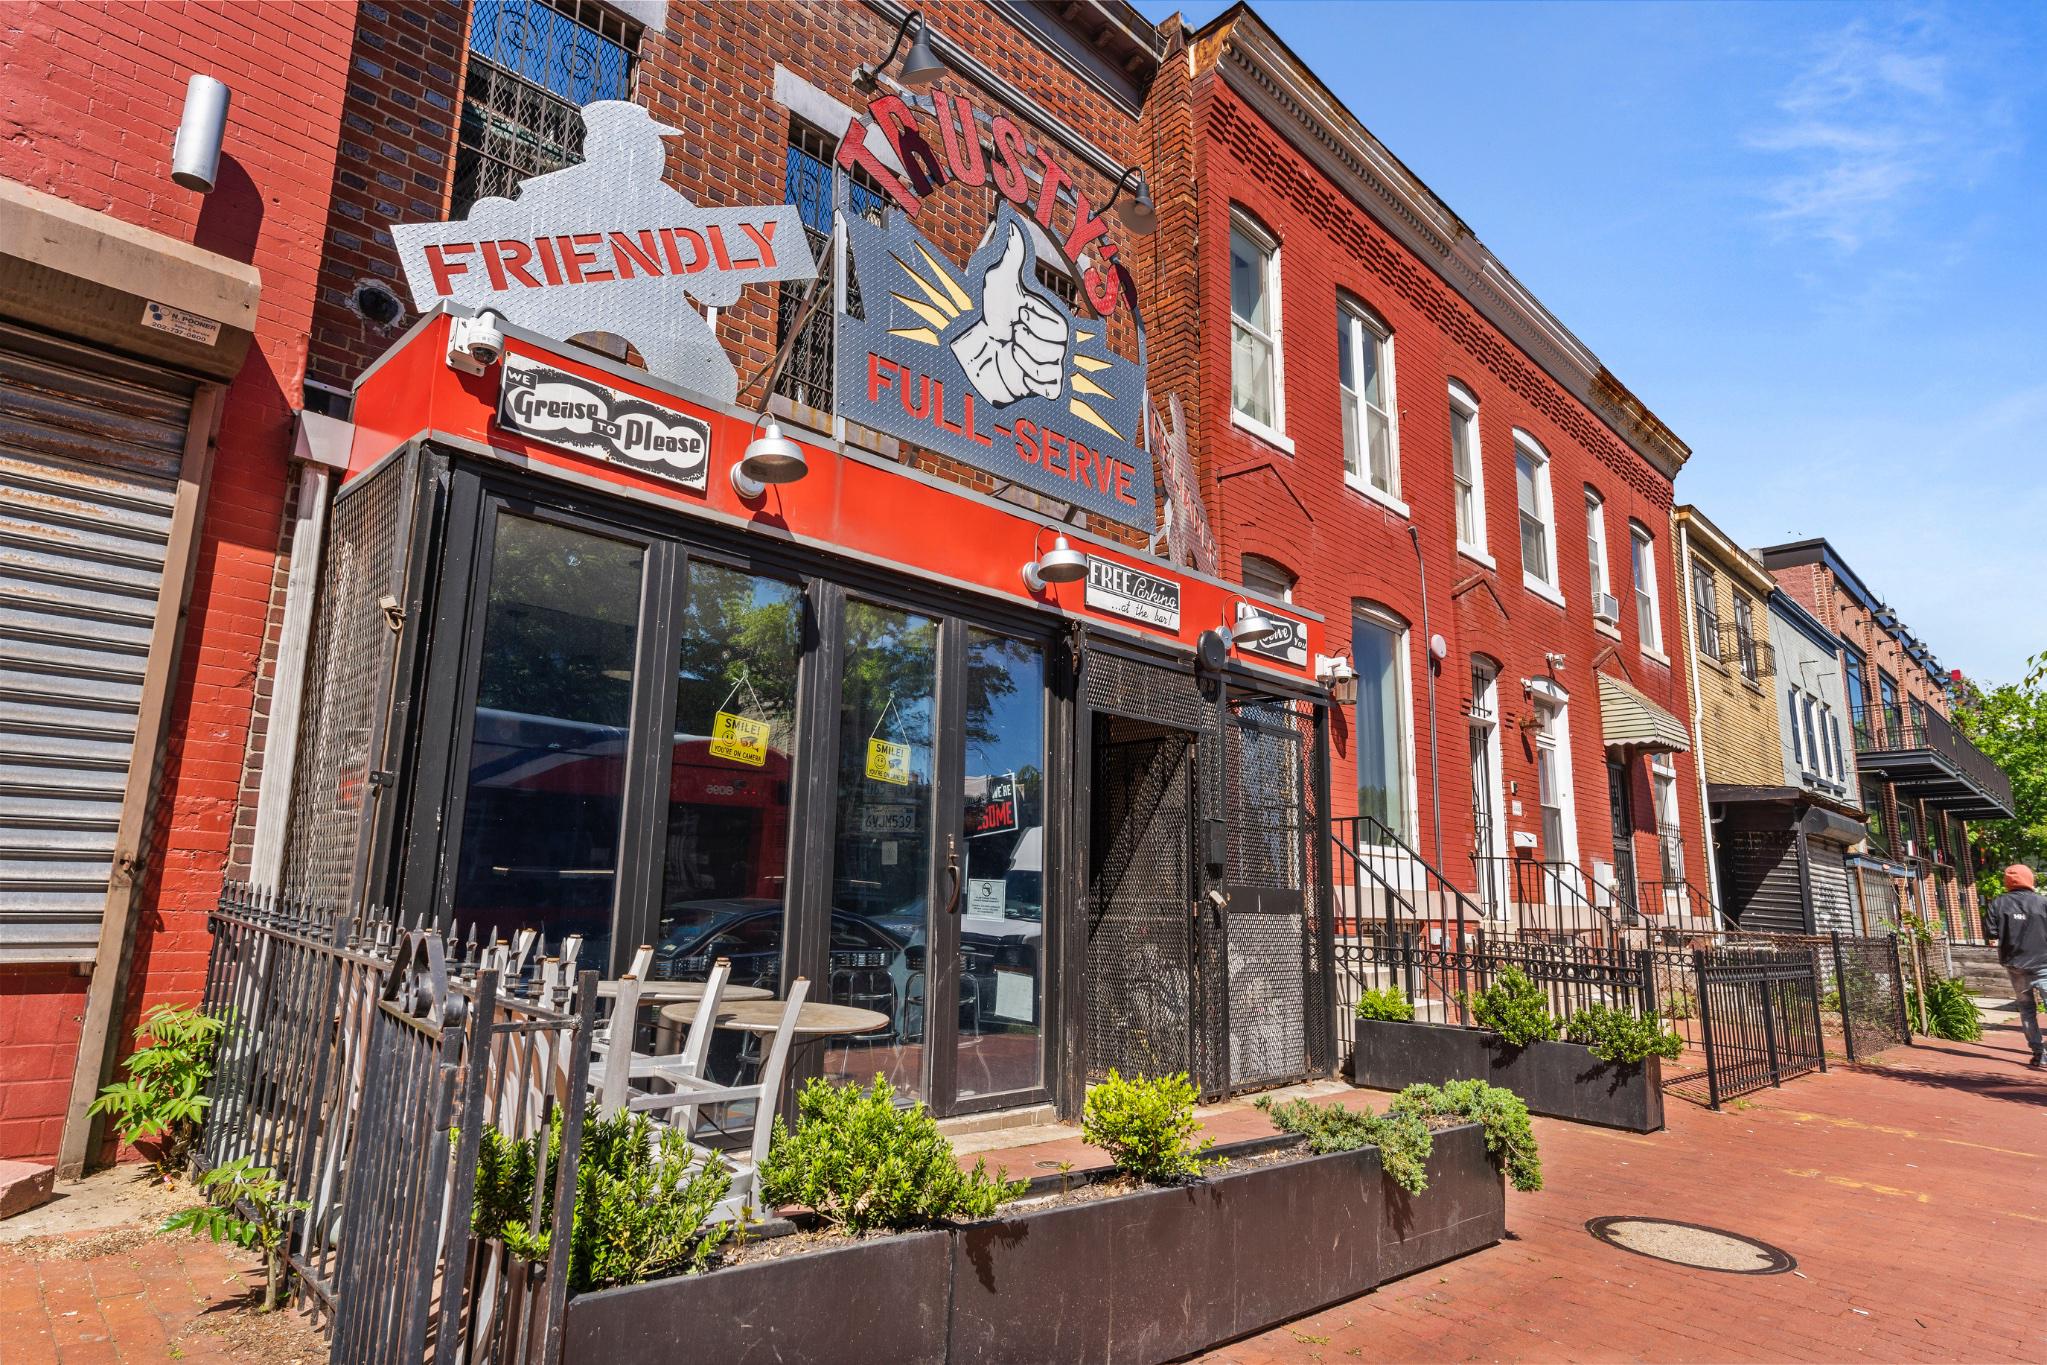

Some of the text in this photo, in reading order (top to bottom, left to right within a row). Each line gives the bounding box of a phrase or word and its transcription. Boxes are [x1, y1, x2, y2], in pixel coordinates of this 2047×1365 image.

[836, 87, 1138, 316] TRUSTY'S
[424, 220, 777, 296] FRIENDLY
[508, 368, 531, 385] WE
[513, 390, 701, 454] Grease TO Please
[867, 351, 1138, 507] FULL-SERVE
[1090, 560, 1178, 608] FREE Parking
[1136, 604, 1149, 619] the
[1154, 608, 1173, 626] bar!
[1294, 636, 1307, 649] You
[725, 718, 761, 736] SMILE!
[714, 745, 762, 763] YOU'RE ON CAMERA
[876, 743, 904, 758] SMILE!
[991, 783, 1012, 799] WE'RE
